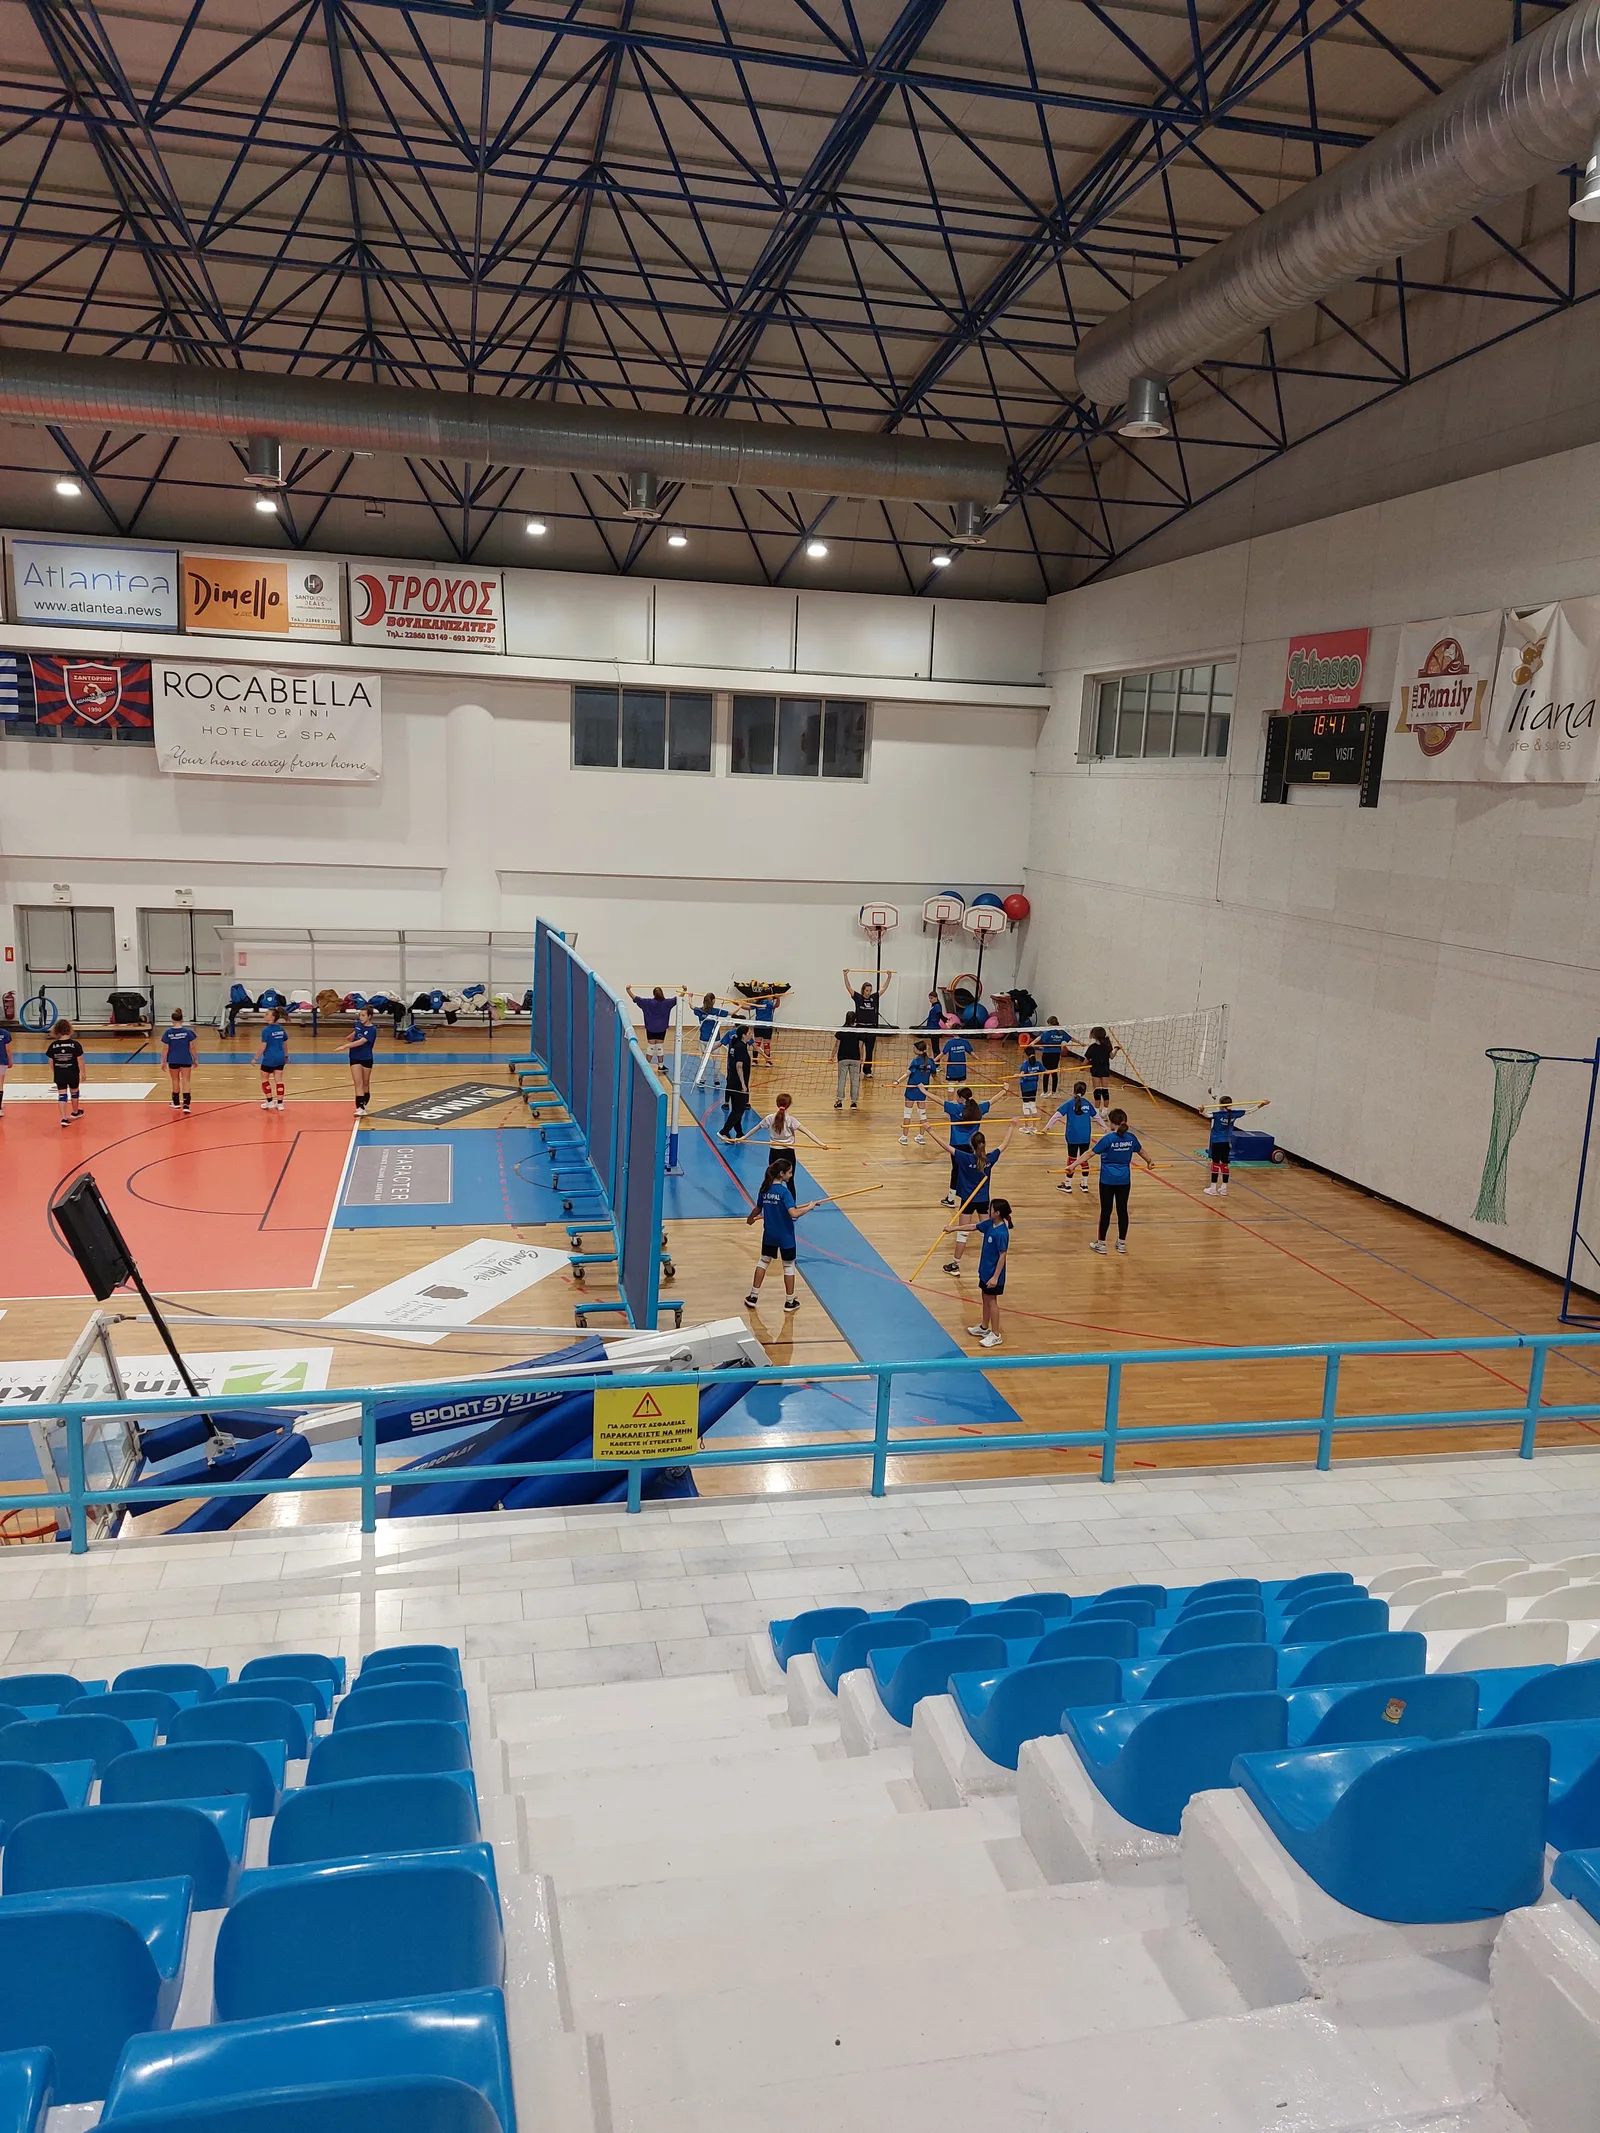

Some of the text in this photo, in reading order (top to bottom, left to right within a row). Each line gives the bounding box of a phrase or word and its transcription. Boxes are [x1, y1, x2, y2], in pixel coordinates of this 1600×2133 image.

[23, 562, 170, 594] Atlantea
[188, 572, 280, 620] Dimello
[387, 575, 497, 616] ΤΡΟΧΟΣ
[34, 600, 162, 617] www.atlantea.news
[386, 616, 496, 633] ΒΟΥΛΚΑΝΙΖΑΤΕΡ
[404, 632, 426, 640] 22860
[427, 633, 448, 641] 83149
[467, 635, 496, 644] 2079737
[1288, 648, 1361, 698] Tabasco
[163, 671, 372, 708] ROCABELLA
[1418, 679, 1473, 715] Family
[209, 703, 329, 717] SANTORINI
[202, 726, 337, 741] HOTEL & SPA
[1313, 715, 1346, 735] 18:41
[1534, 738, 1541, 751] &
[171, 745, 368, 773] Your home away from home
[1295, 748, 1314, 761] HOME
[407, 1097, 492, 1120] VIMAR
[391, 1148, 414, 1200] CHARACTER
[648, 1420, 686, 1428] ΑΣΦΑΛΕΙΑΣ
[600, 1431, 660, 1439] ΠΑΡΑΚΑΛΕΙΣΤΕ
[649, 1438, 683, 1446] ΣΤΕΚΕΣΤΕ
